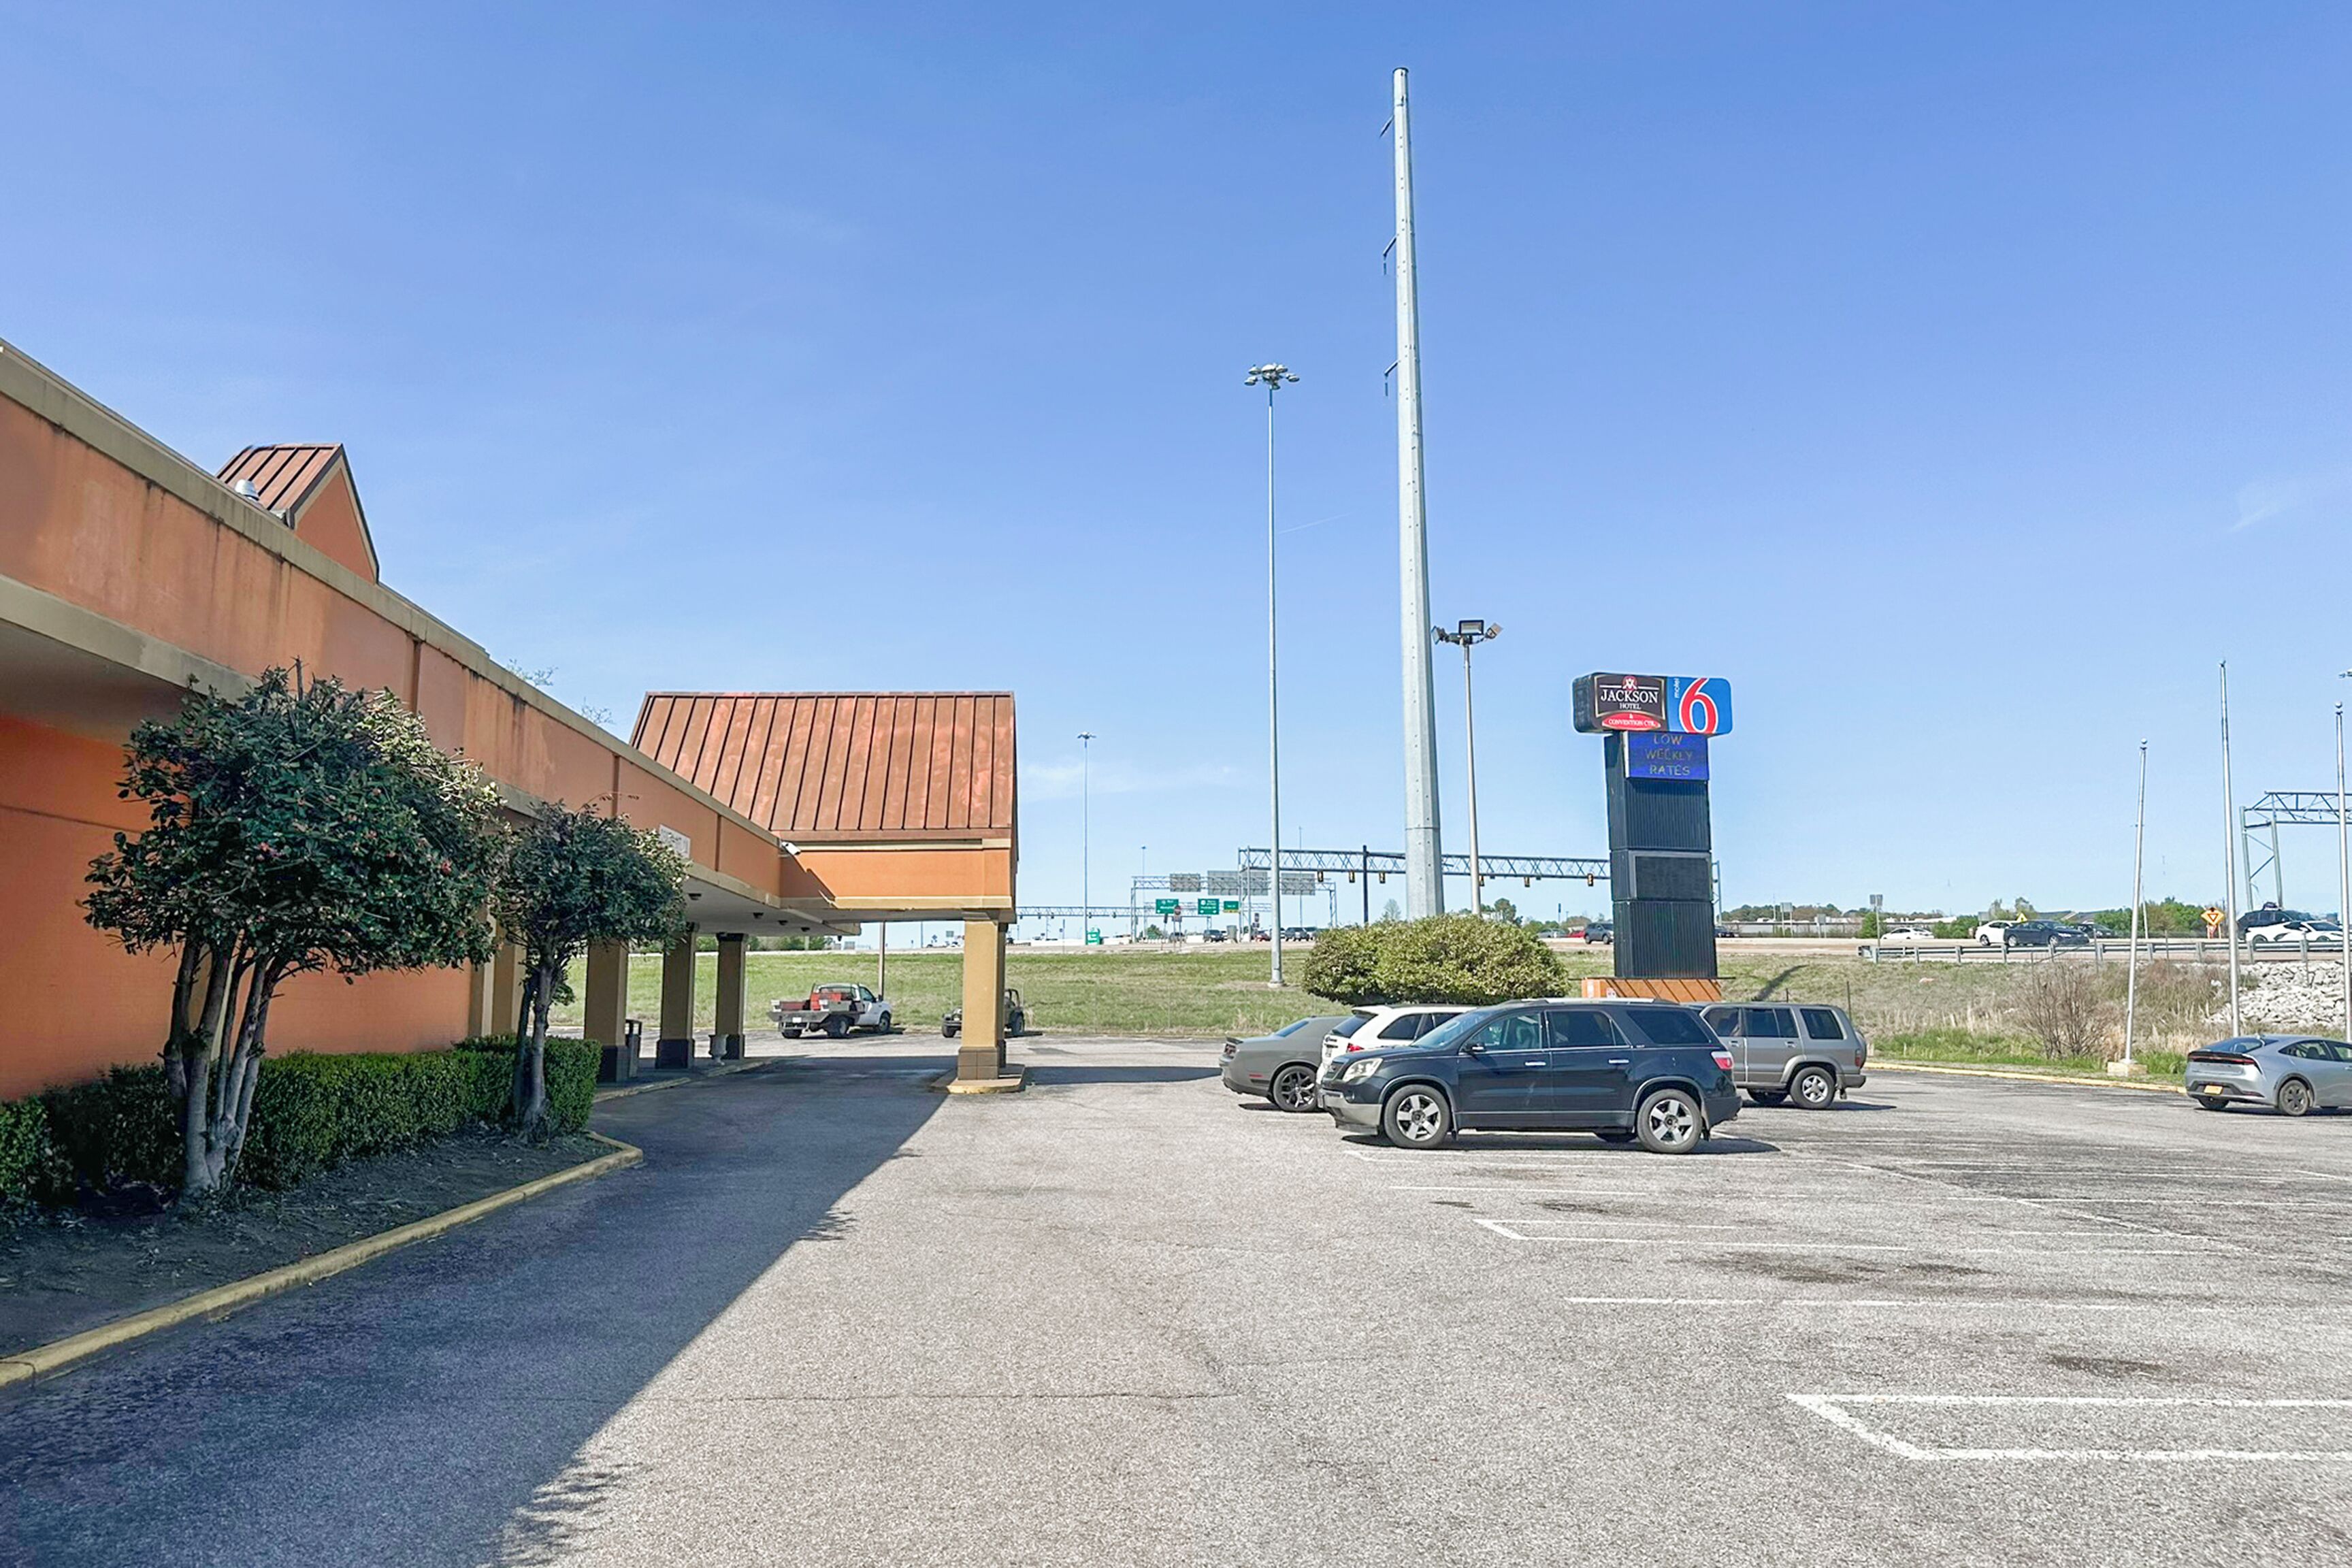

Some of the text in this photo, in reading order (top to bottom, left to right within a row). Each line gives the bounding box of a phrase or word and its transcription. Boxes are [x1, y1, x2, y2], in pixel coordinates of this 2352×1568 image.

[1601, 689, 1659, 703] JACKSON
[1679, 678, 1718, 734] 6
[1654, 734, 1682, 745] LOW
[1650, 764, 1690, 775] RATES
